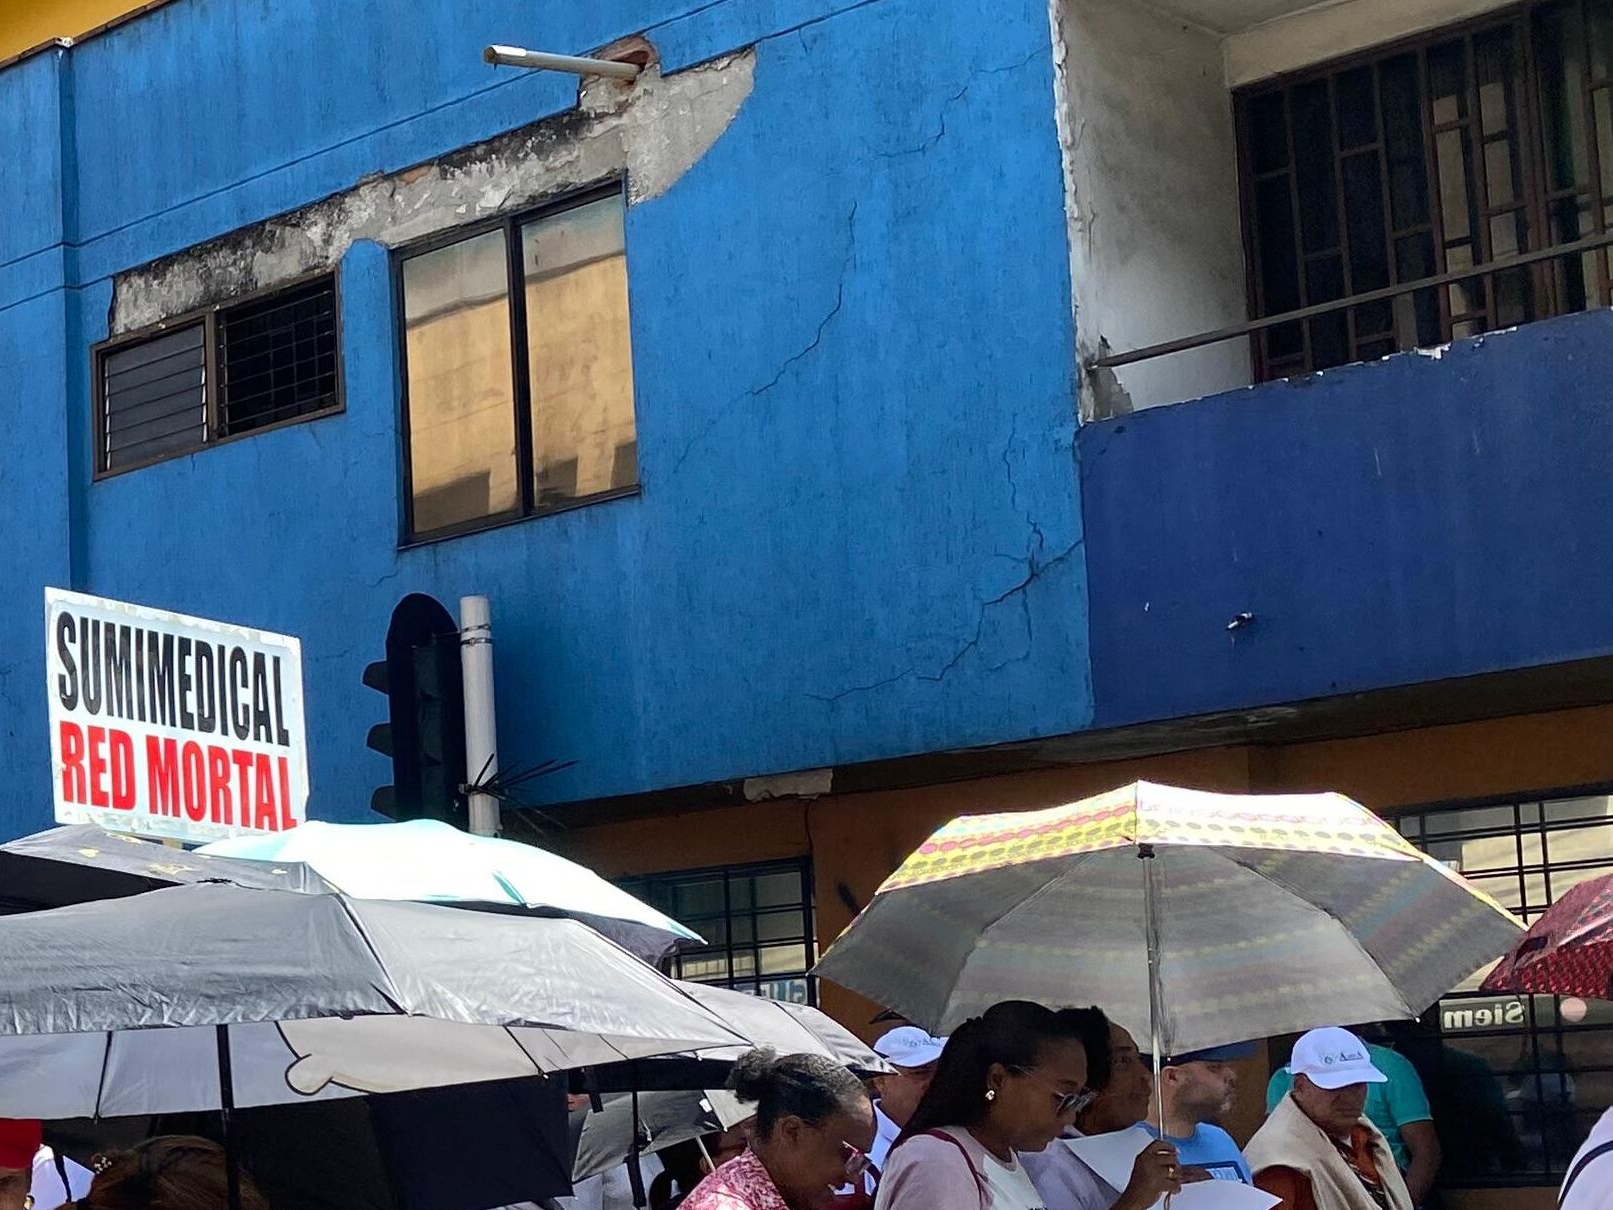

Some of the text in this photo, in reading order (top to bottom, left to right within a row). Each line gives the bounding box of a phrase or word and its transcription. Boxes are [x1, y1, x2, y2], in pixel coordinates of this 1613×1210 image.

[56, 611, 291, 748] SUMIMEDICAL
[59, 720, 298, 833] RED MORTAL
